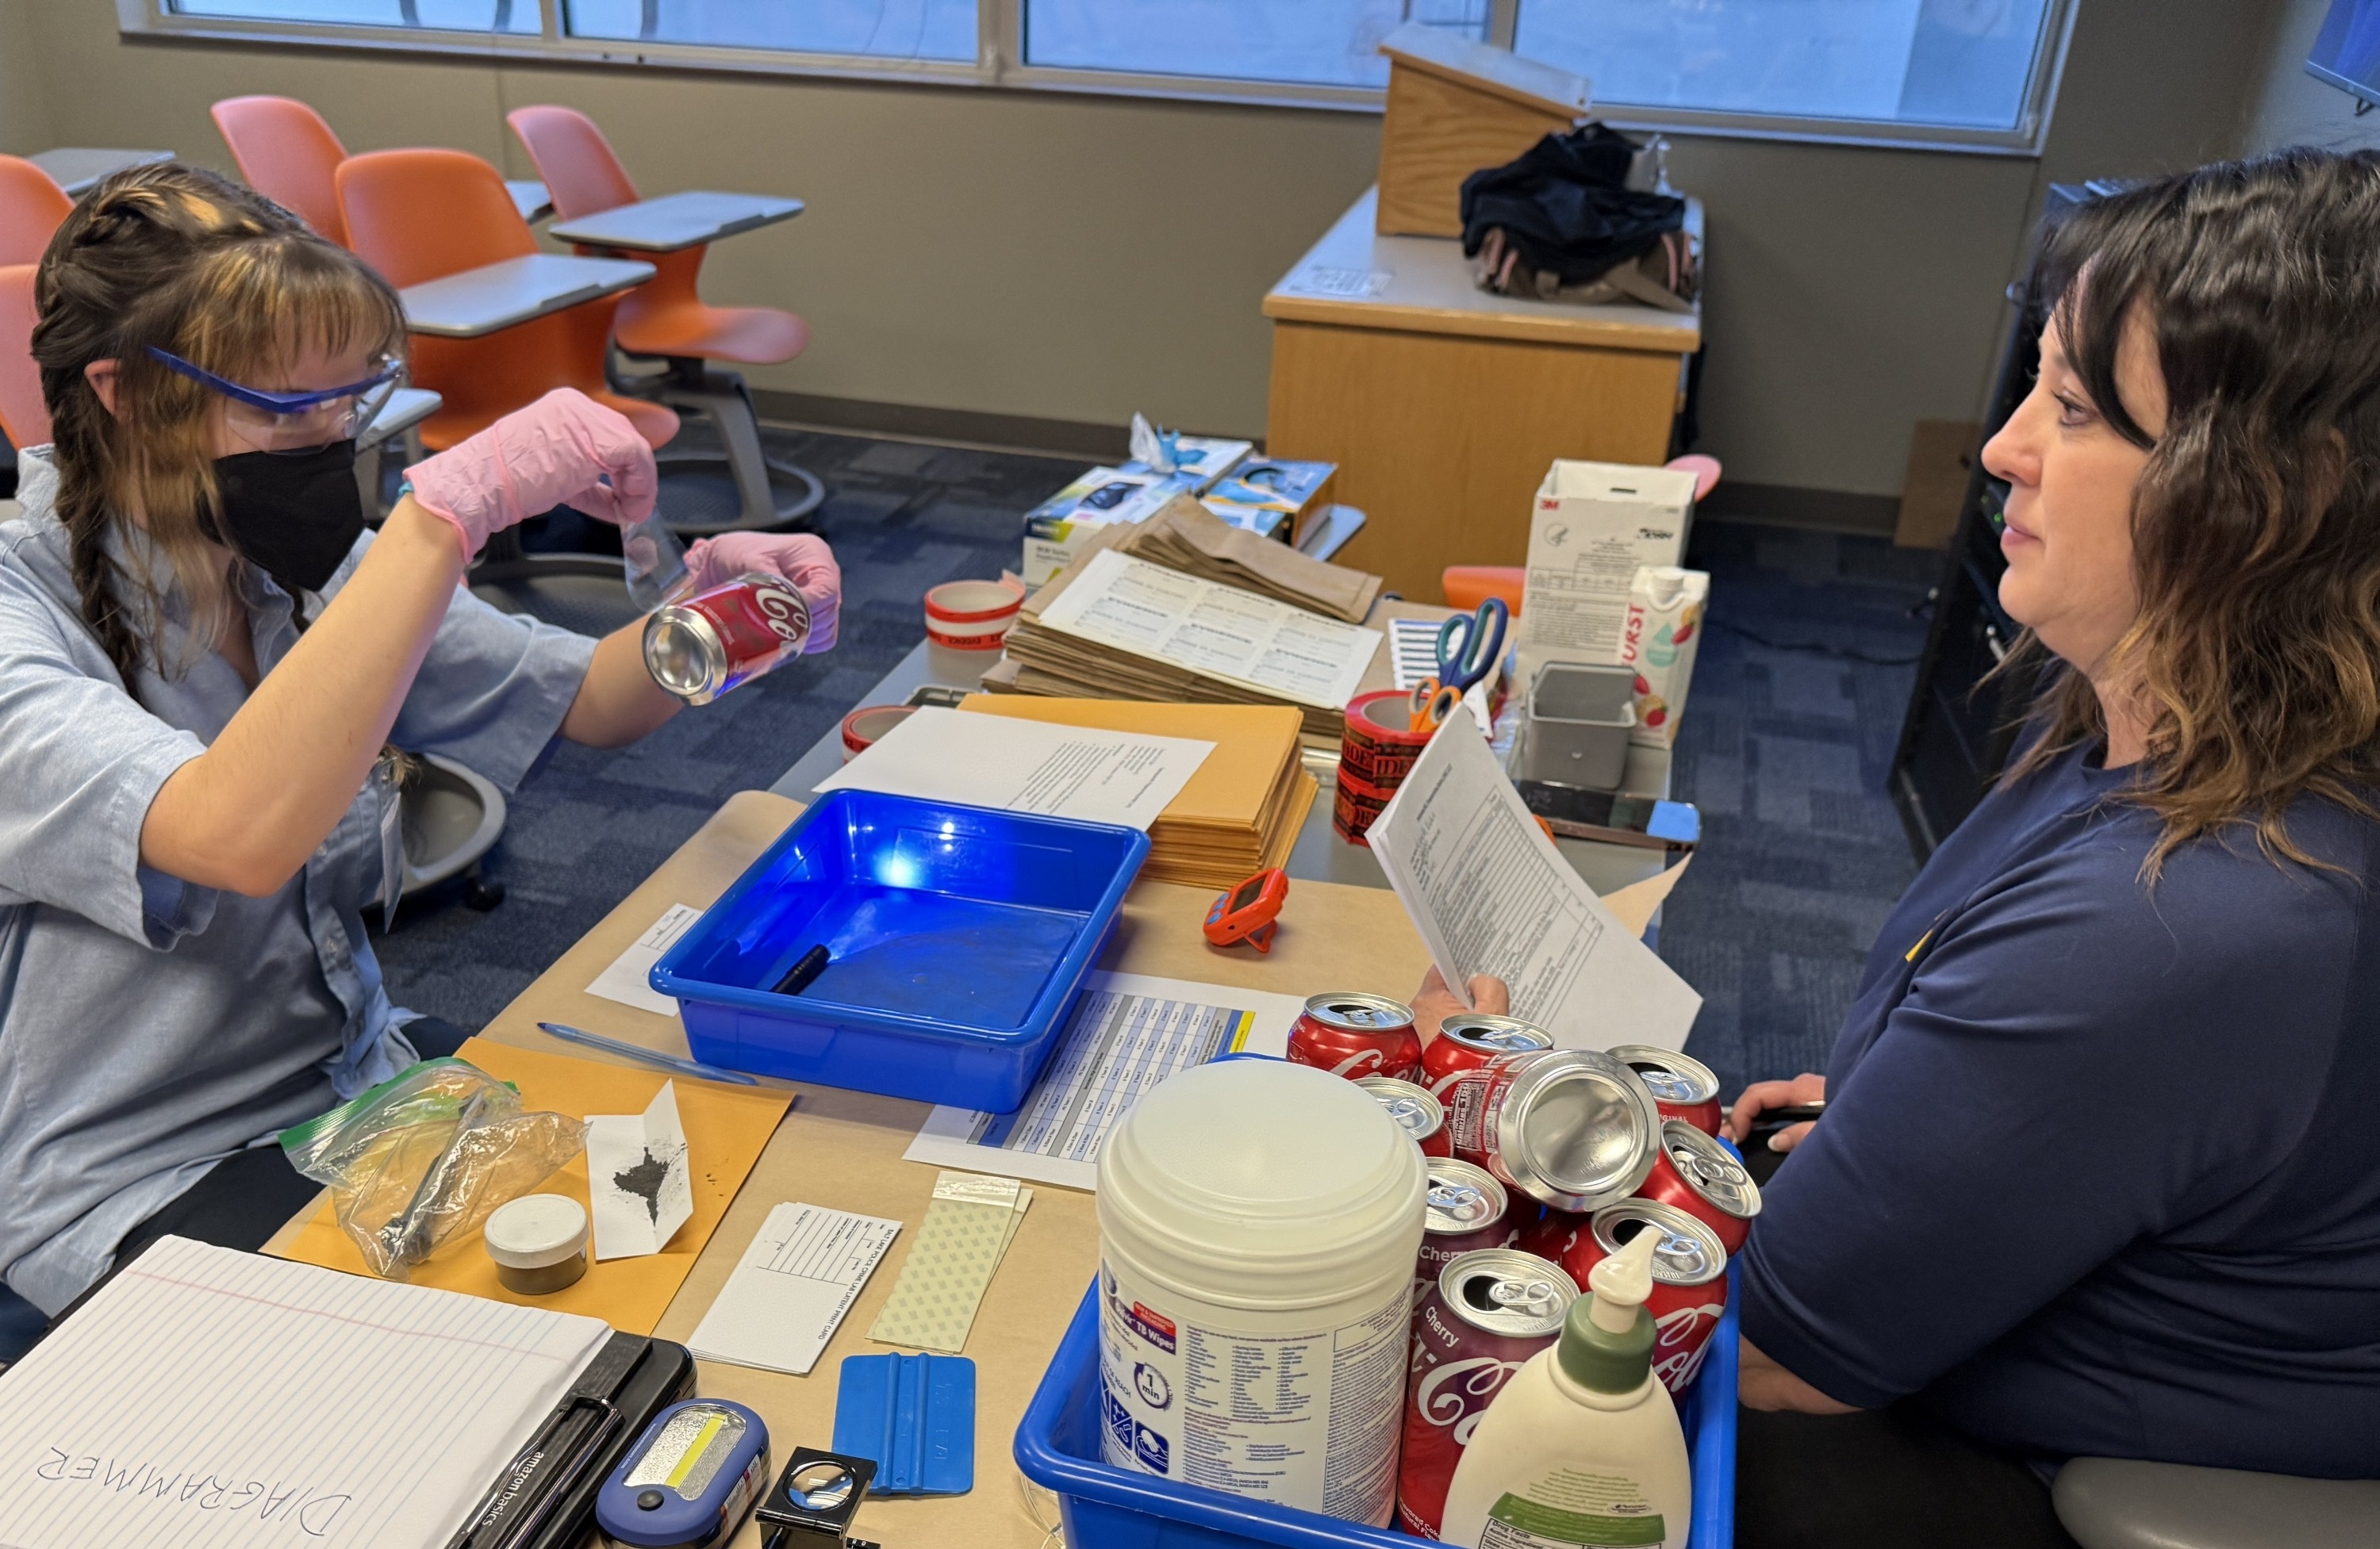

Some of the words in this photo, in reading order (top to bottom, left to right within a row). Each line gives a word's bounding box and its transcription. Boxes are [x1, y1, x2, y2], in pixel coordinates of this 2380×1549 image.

[1540, 500, 1560, 511] 3M
[1622, 602, 1645, 665] URST
[1418, 1246, 1470, 1262] Cher
[1137, 1321, 1147, 1335] TB
[1148, 1329, 1174, 1350] Wipes
[1426, 1306, 1460, 1348] Cherry
[1147, 1374, 1153, 1387] 1
[1142, 1384, 1160, 1400] min
[36, 1447, 352, 1536] DIAGRAMMER
[1488, 1528, 1508, 1537] Active
[1492, 1520, 1509, 1531] Drug
[1511, 1528, 1531, 1539] Facts
